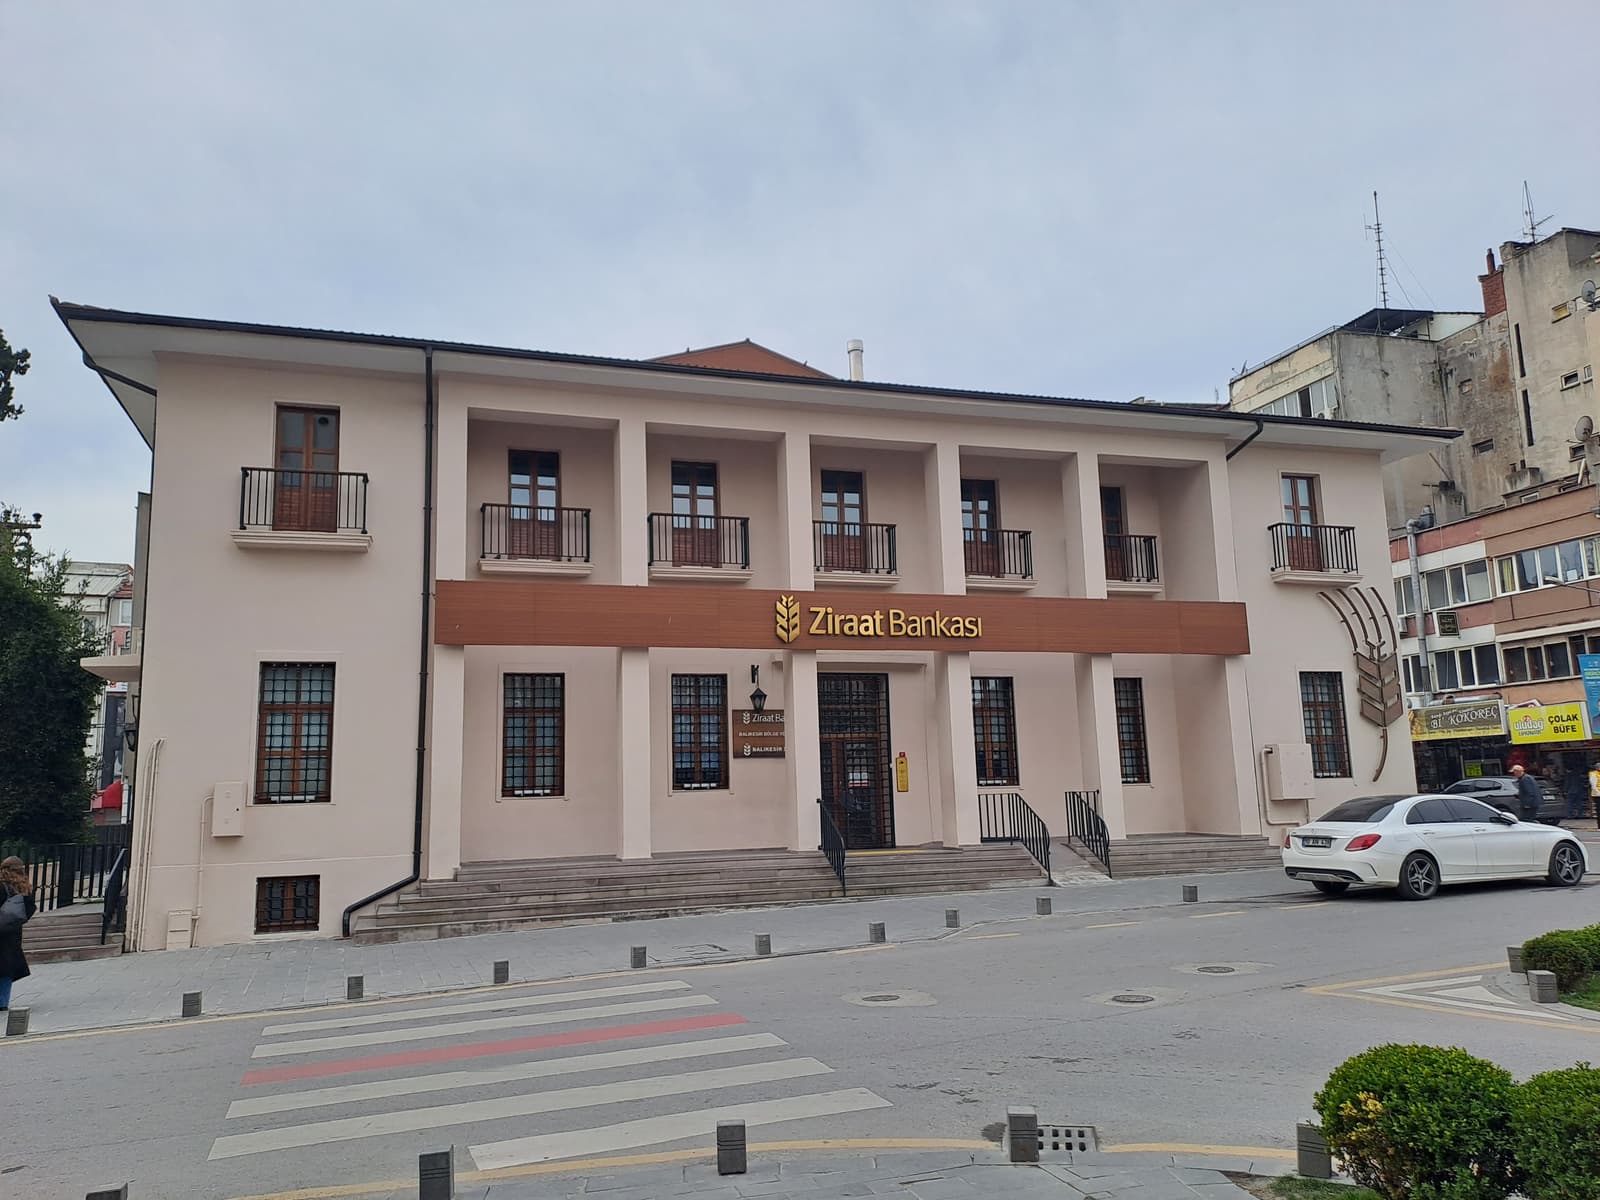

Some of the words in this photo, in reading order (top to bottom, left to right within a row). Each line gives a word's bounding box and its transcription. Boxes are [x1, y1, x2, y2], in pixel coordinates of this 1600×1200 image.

[809, 606, 884, 636] Ziraat
[888, 608, 982, 638] Bankası
[752, 713, 774, 722] Ziraat
[1448, 705, 1498, 726] KOKOREÇ
[1548, 713, 1579, 725] ÇOLAK
[1553, 725, 1577, 734] BÜFE
